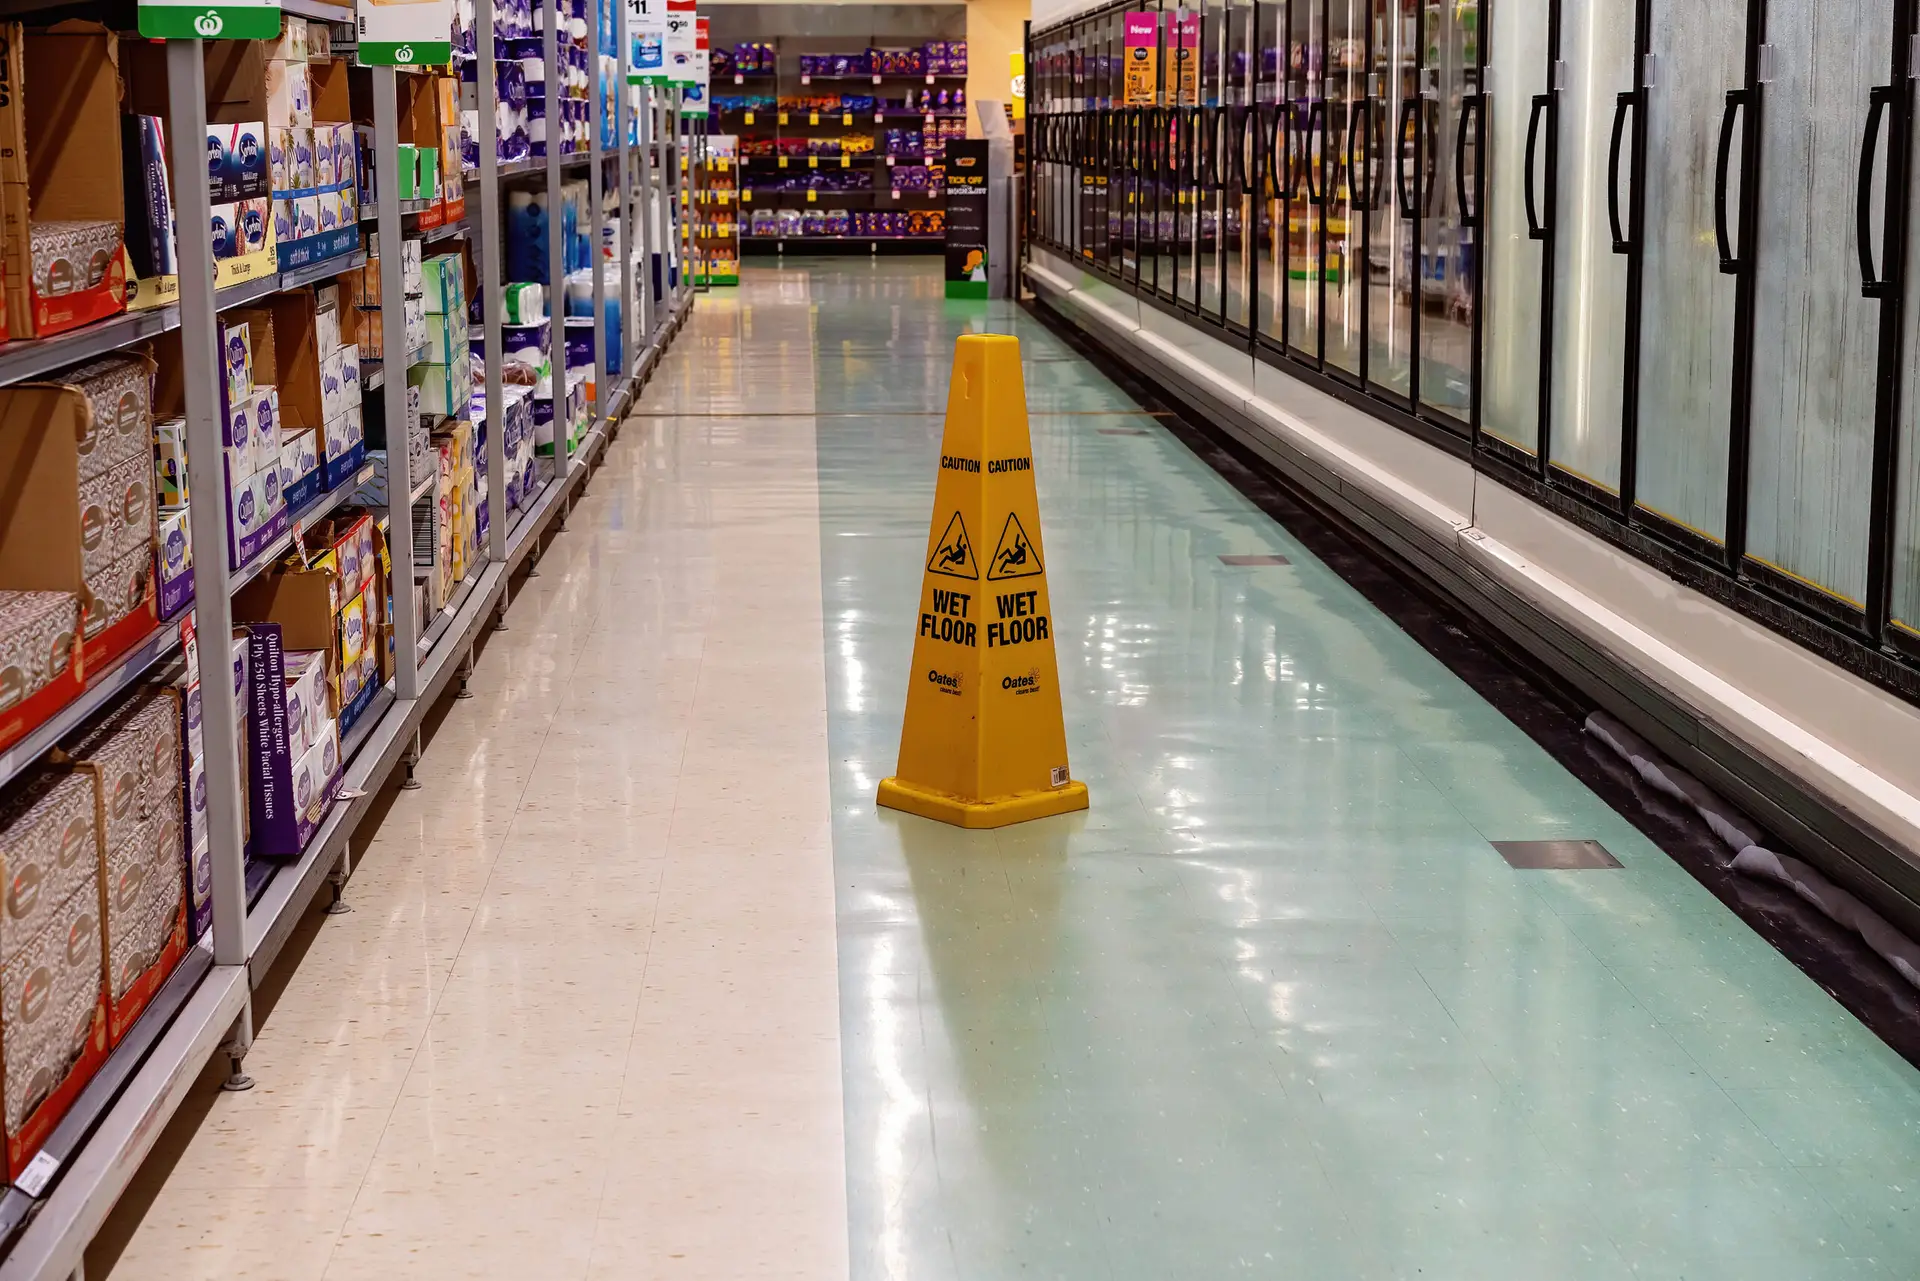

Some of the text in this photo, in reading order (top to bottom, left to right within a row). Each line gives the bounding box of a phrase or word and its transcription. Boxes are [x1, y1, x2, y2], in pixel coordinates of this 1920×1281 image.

[1130, 25, 1152, 34] New
[207, 143, 223, 161] orbent
[240, 140, 259, 164] Sorbent
[211, 222, 228, 242] orbent
[244, 216, 263, 240] Sorbent
[941, 455, 981, 473] CAUTION
[988, 457, 1031, 473] CAUTION
[933, 588, 971, 618] WET
[996, 590, 1037, 619] WET
[920, 613, 977, 647] FLOOR
[987, 615, 1049, 648] FLOOR
[251, 643, 264, 660] Ply
[255, 661, 266, 680] 250
[928, 669, 959, 689] Oates
[1001, 675, 1035, 690] Oates
[256, 683, 267, 717] Sheets
[265, 633, 286, 755] Quilton Hypo-allergenic
[259, 718, 270, 748] White
[261, 750, 273, 779] Facial
[263, 781, 274, 820] Tissues
